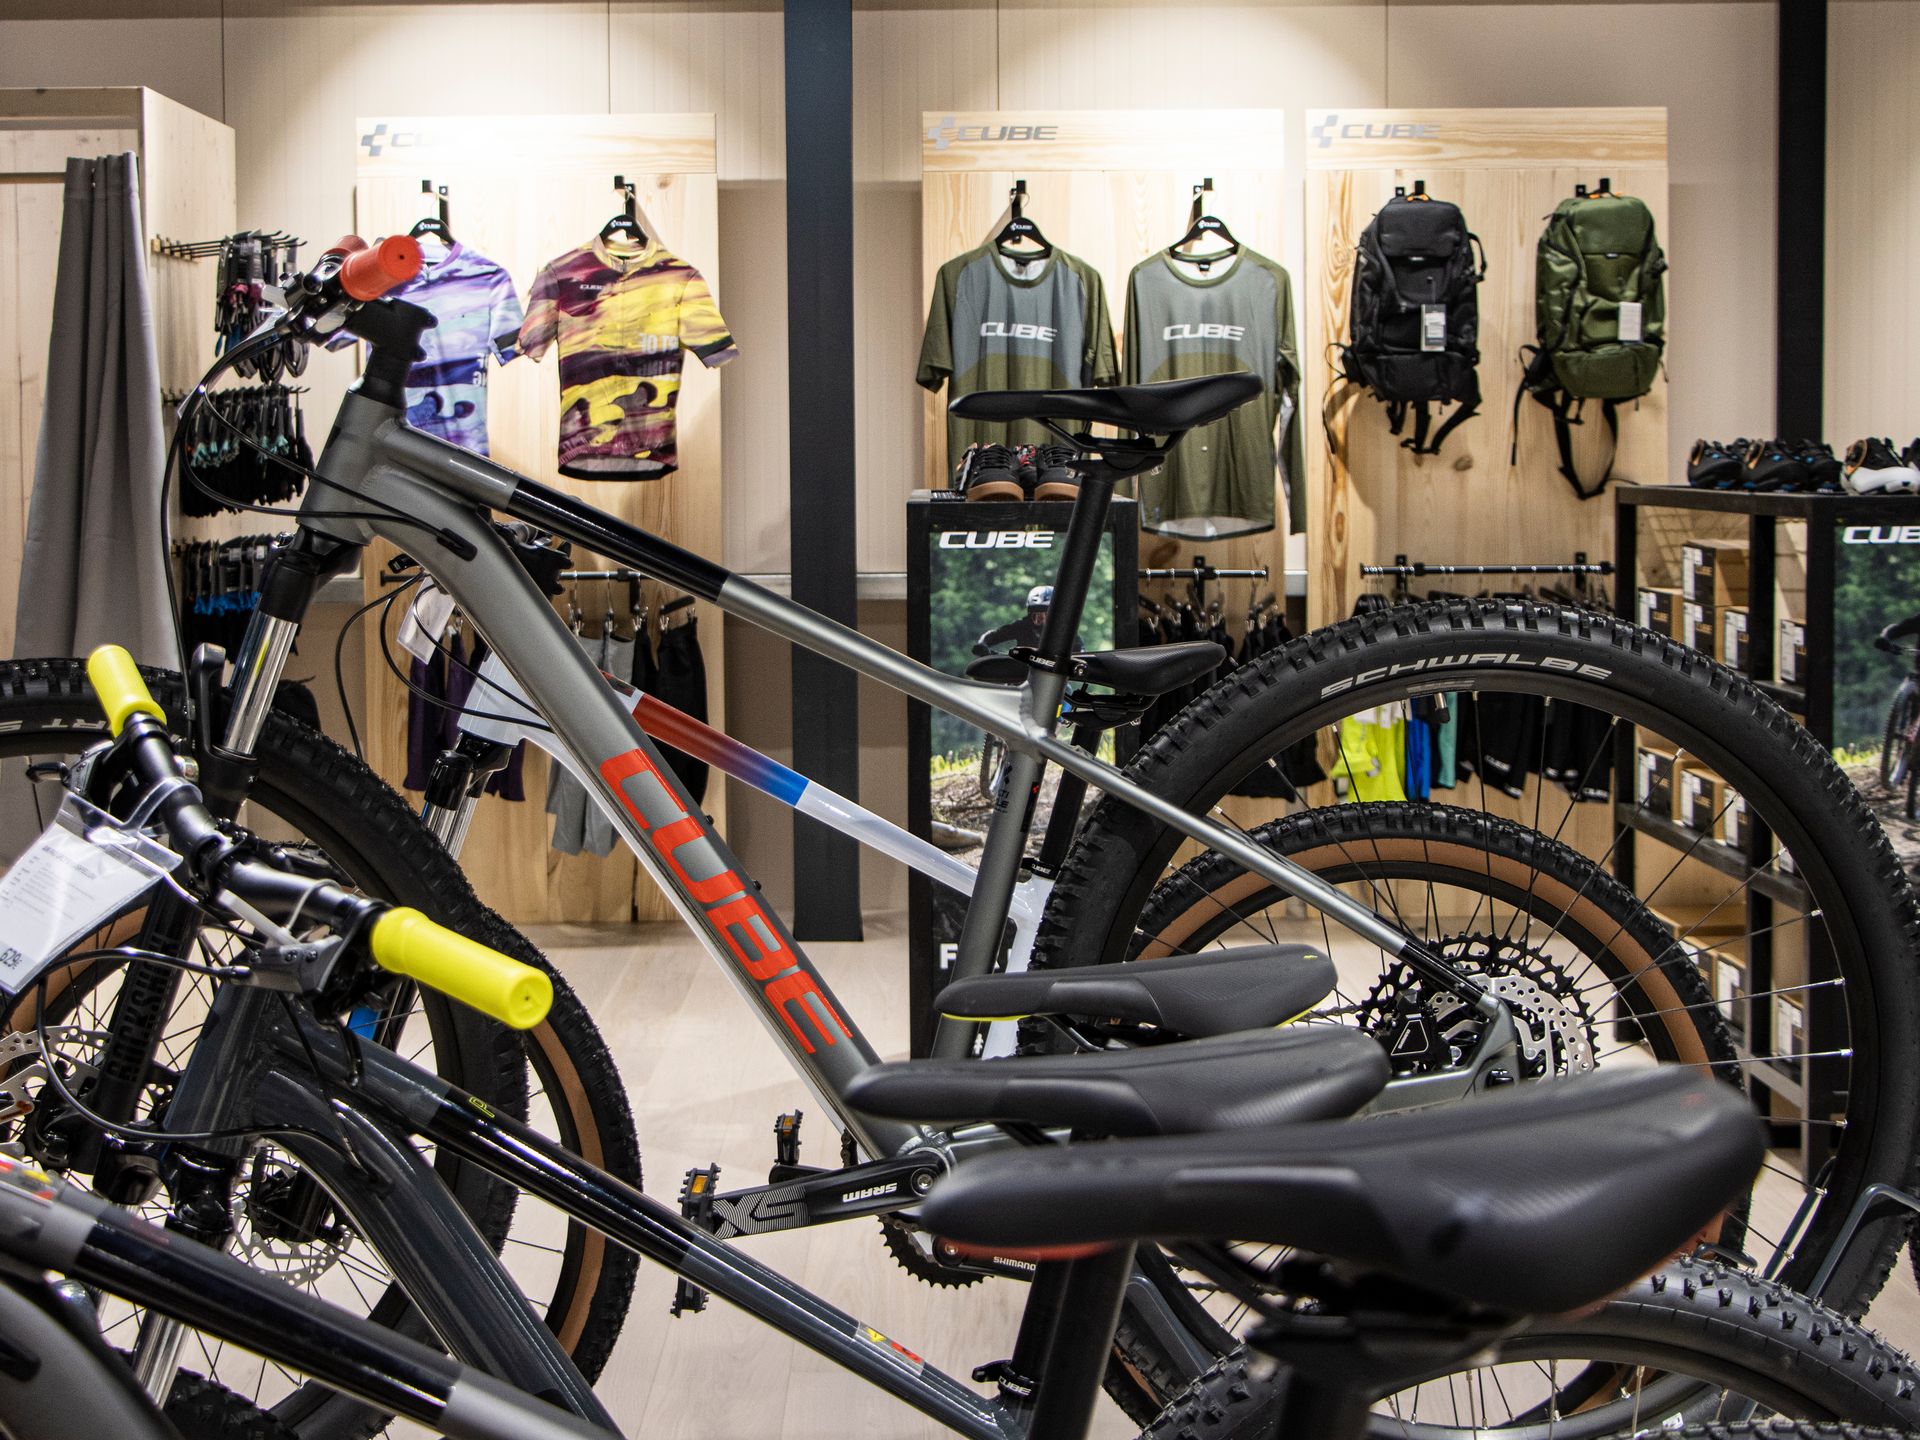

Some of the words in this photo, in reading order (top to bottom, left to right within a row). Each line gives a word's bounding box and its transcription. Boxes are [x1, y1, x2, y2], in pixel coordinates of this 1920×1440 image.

[957, 126, 1058, 141] CUBE
[1341, 124, 1441, 139] CUBE
[980, 321, 1058, 342] CUBE
[1163, 323, 1245, 341] CUBE
[939, 530, 1055, 549] CUBE
[1842, 526, 1920, 545] CUB
[1320, 653, 1613, 699] SCHWALBE
[600, 748, 853, 1054] CUBE
[842, 1183, 898, 1203] SRAM
[993, 1256, 1036, 1271] SHIMANO
[999, 1376, 1032, 1396] CUBE
